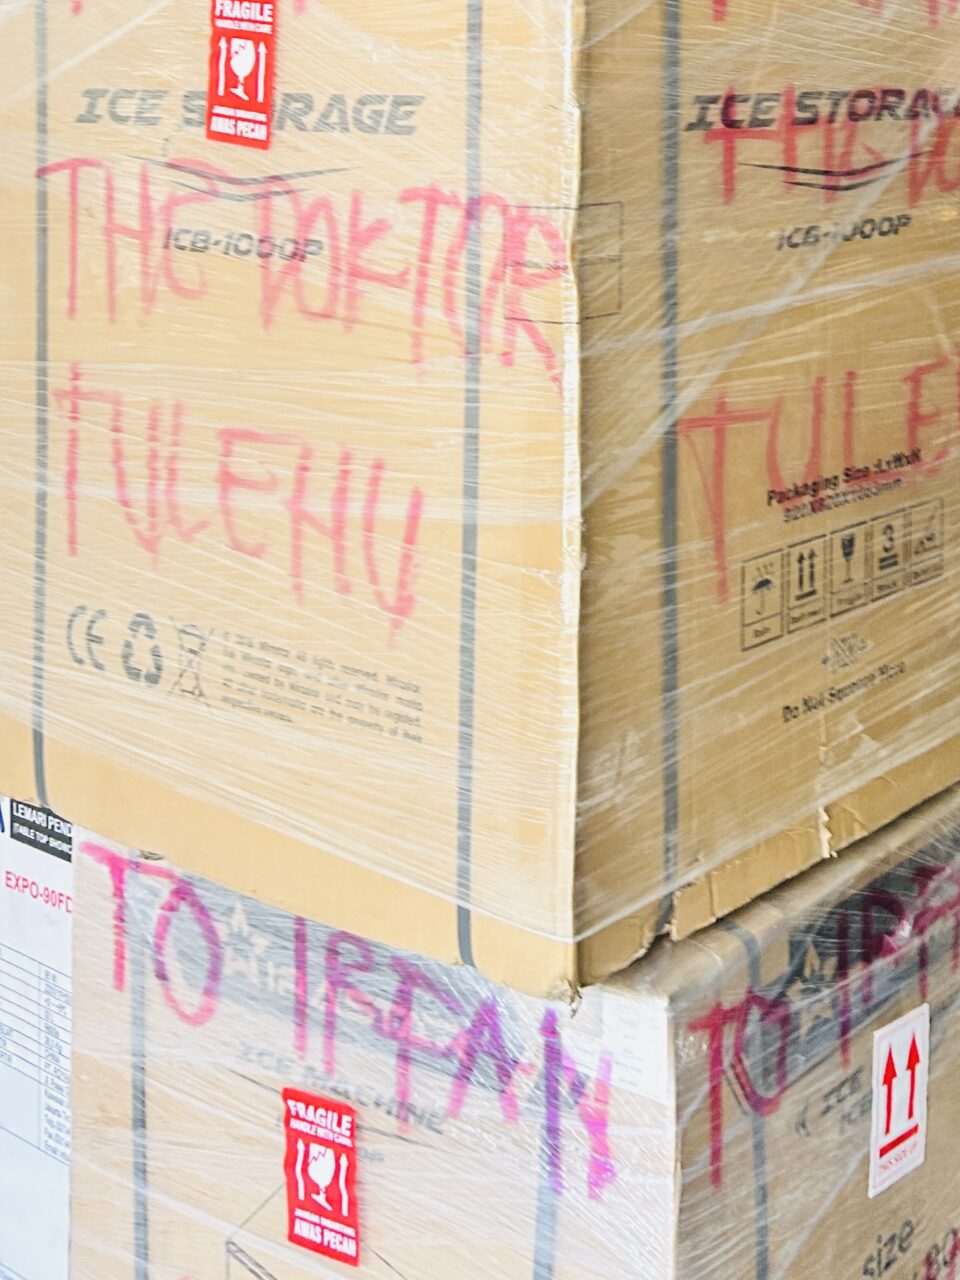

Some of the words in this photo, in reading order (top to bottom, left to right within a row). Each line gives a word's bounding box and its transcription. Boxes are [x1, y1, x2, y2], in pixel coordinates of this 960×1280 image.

[75, 88, 166, 124] ICE
[180, 90, 426, 136] SRAGE
[684, 92, 782, 132] ICE
[286, 1099, 353, 1137] FRAGILE
[293, 1218, 323, 1244] AWAS
[322, 1228, 357, 1257] PECAH
